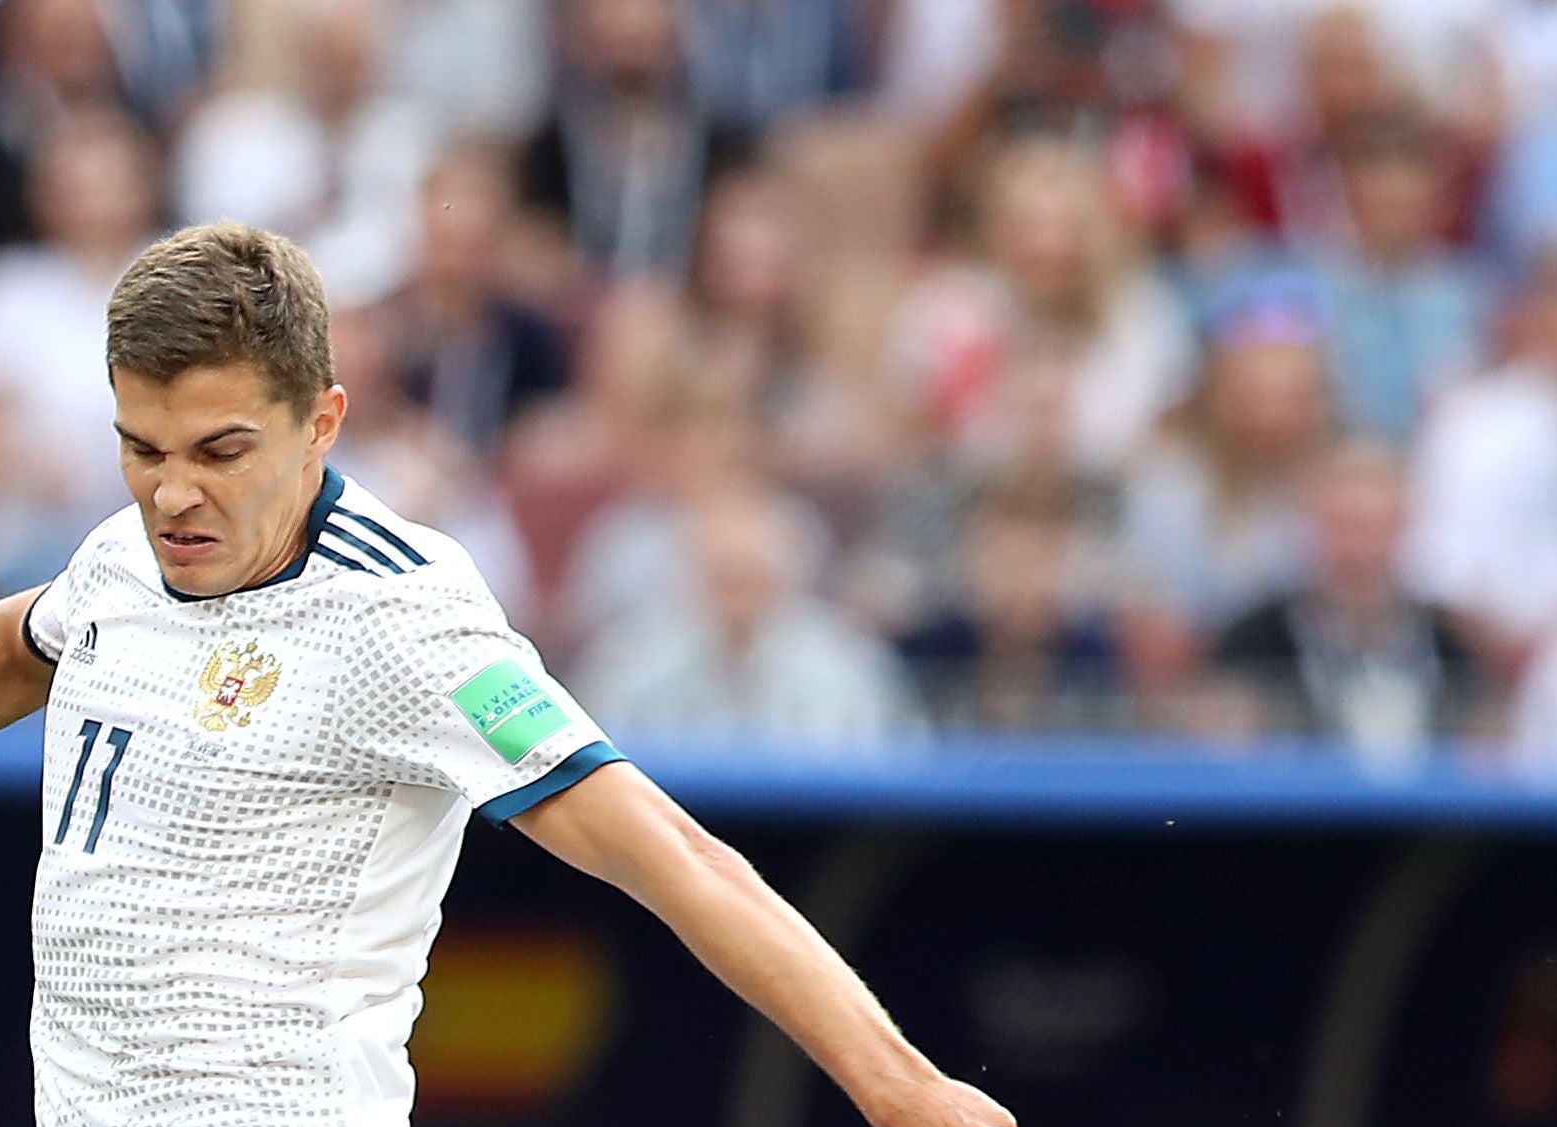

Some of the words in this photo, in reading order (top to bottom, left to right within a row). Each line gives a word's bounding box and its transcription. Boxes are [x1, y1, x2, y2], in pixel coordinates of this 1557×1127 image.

[472, 678, 531, 719] LIVING
[527, 700, 553, 718] FIFA
[53, 718, 133, 855] 11
